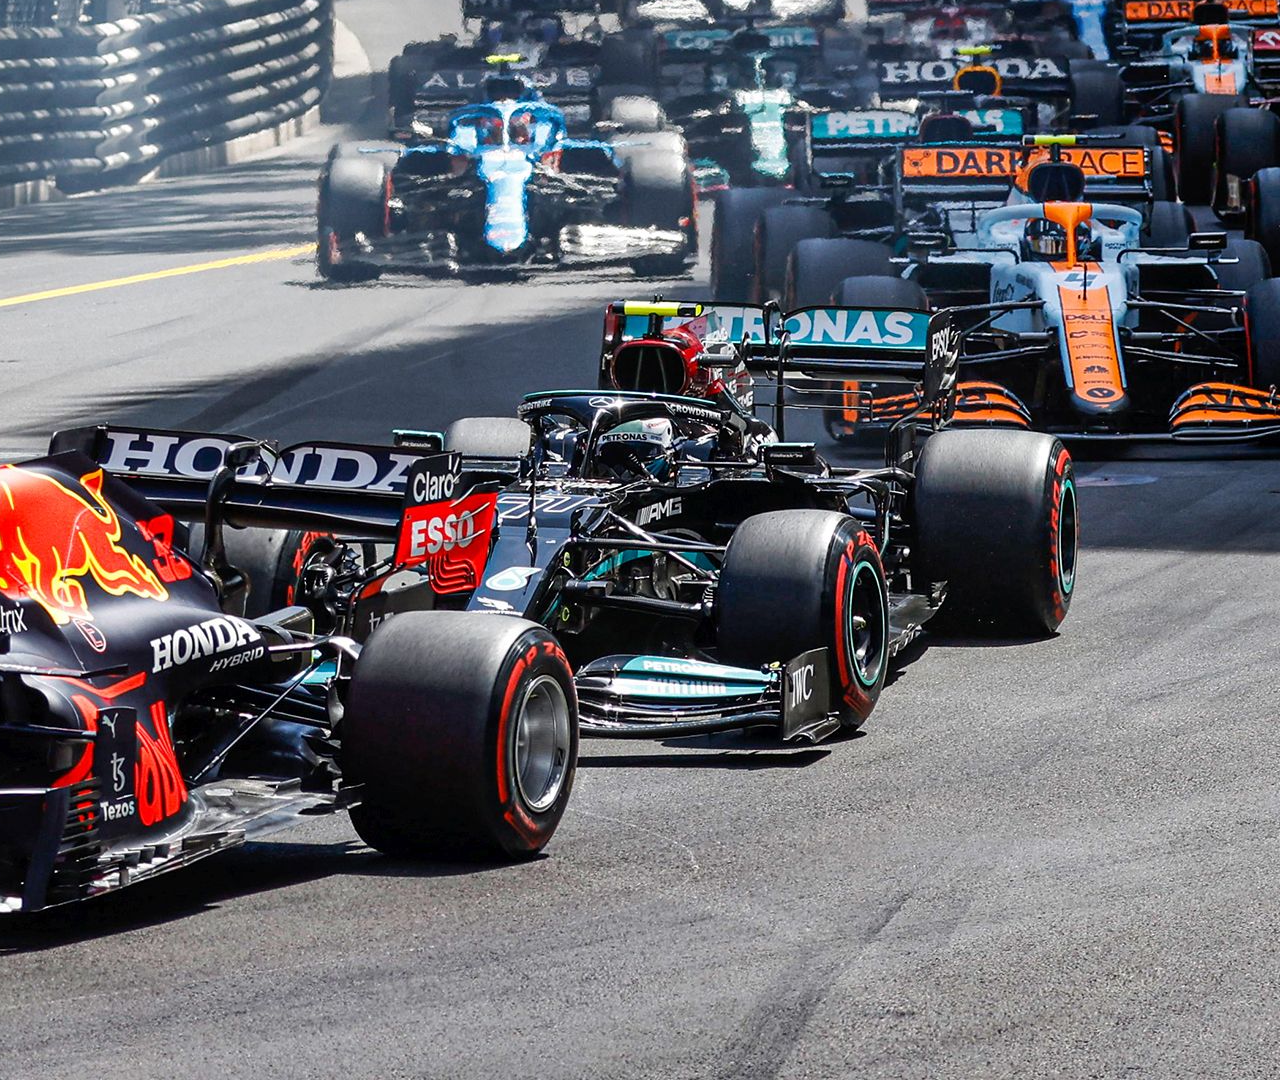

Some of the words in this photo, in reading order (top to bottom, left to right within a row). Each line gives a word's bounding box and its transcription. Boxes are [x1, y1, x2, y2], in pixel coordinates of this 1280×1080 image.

[422, 67, 592, 88] ALNE
[882, 57, 1068, 83] HODA
[827, 109, 1005, 136] PETRAS
[935, 151, 1140, 175] DARKACE
[650, 306, 914, 345] TRONAS
[602, 433, 648, 442] PETRONAS
[98, 431, 415, 493] HONDA
[412, 472, 456, 503] Claro
[410, 510, 474, 558] ESSO
[150, 615, 262, 674] HONDA
[209, 646, 265, 672] HYBRID
[791, 664, 815, 708] IWC
[100, 799, 135, 821] Tezos
